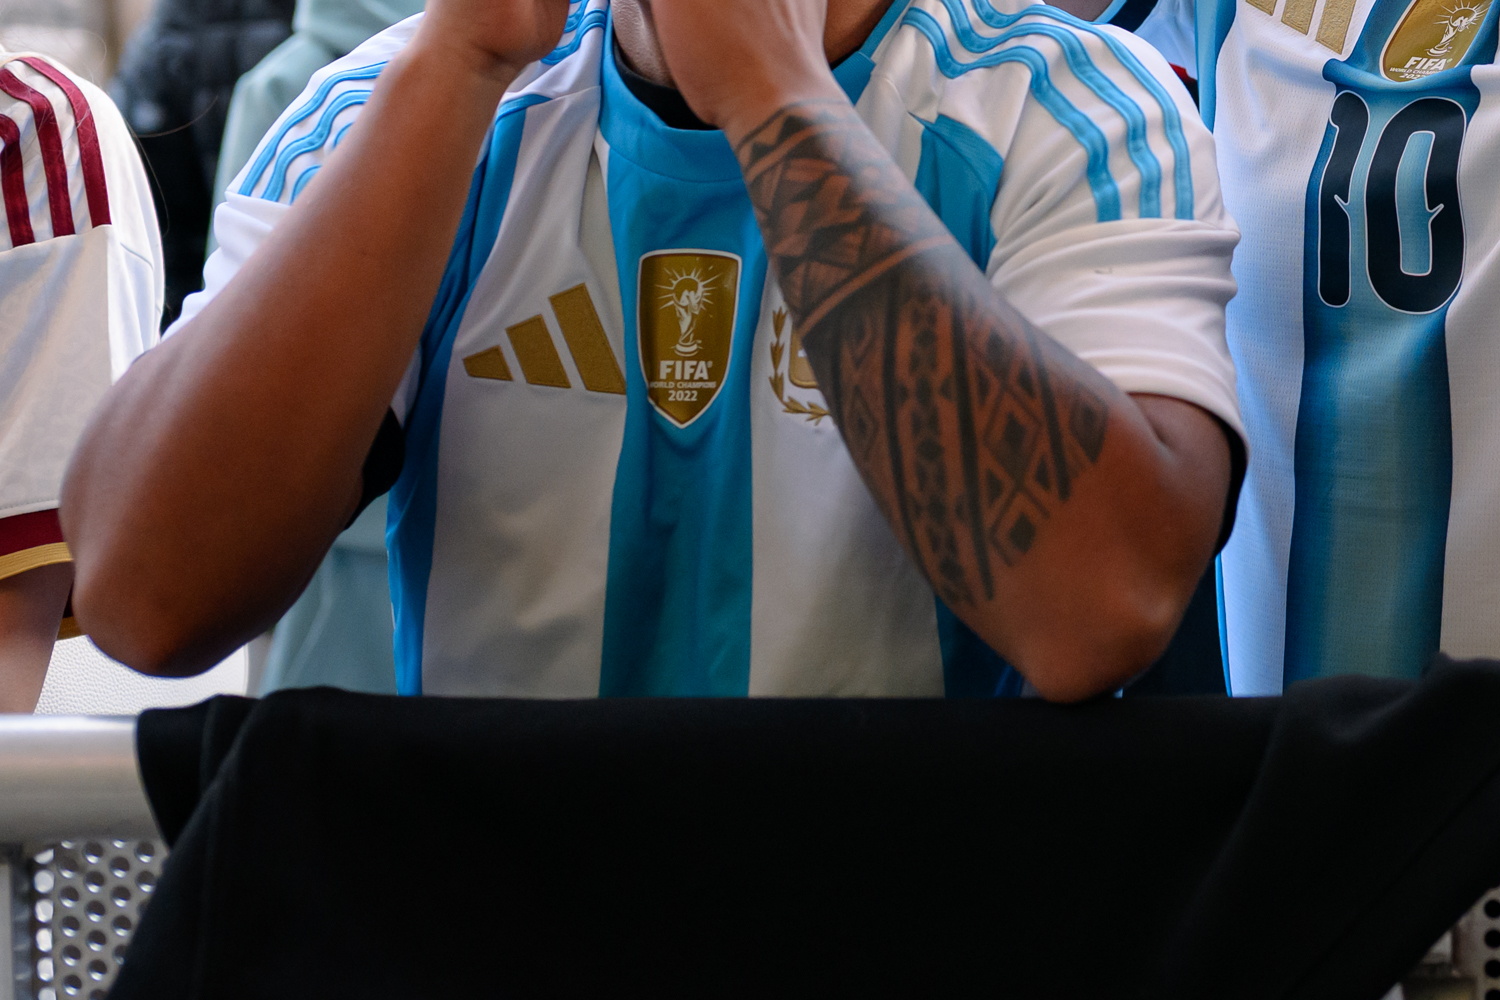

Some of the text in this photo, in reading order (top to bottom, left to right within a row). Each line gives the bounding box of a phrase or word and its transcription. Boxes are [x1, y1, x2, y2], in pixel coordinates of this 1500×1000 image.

[1404, 56, 1447, 71] FIFA
[1318, 91, 1467, 314] 10
[660, 360, 708, 380] FIFA
[668, 390, 698, 402] 2022
